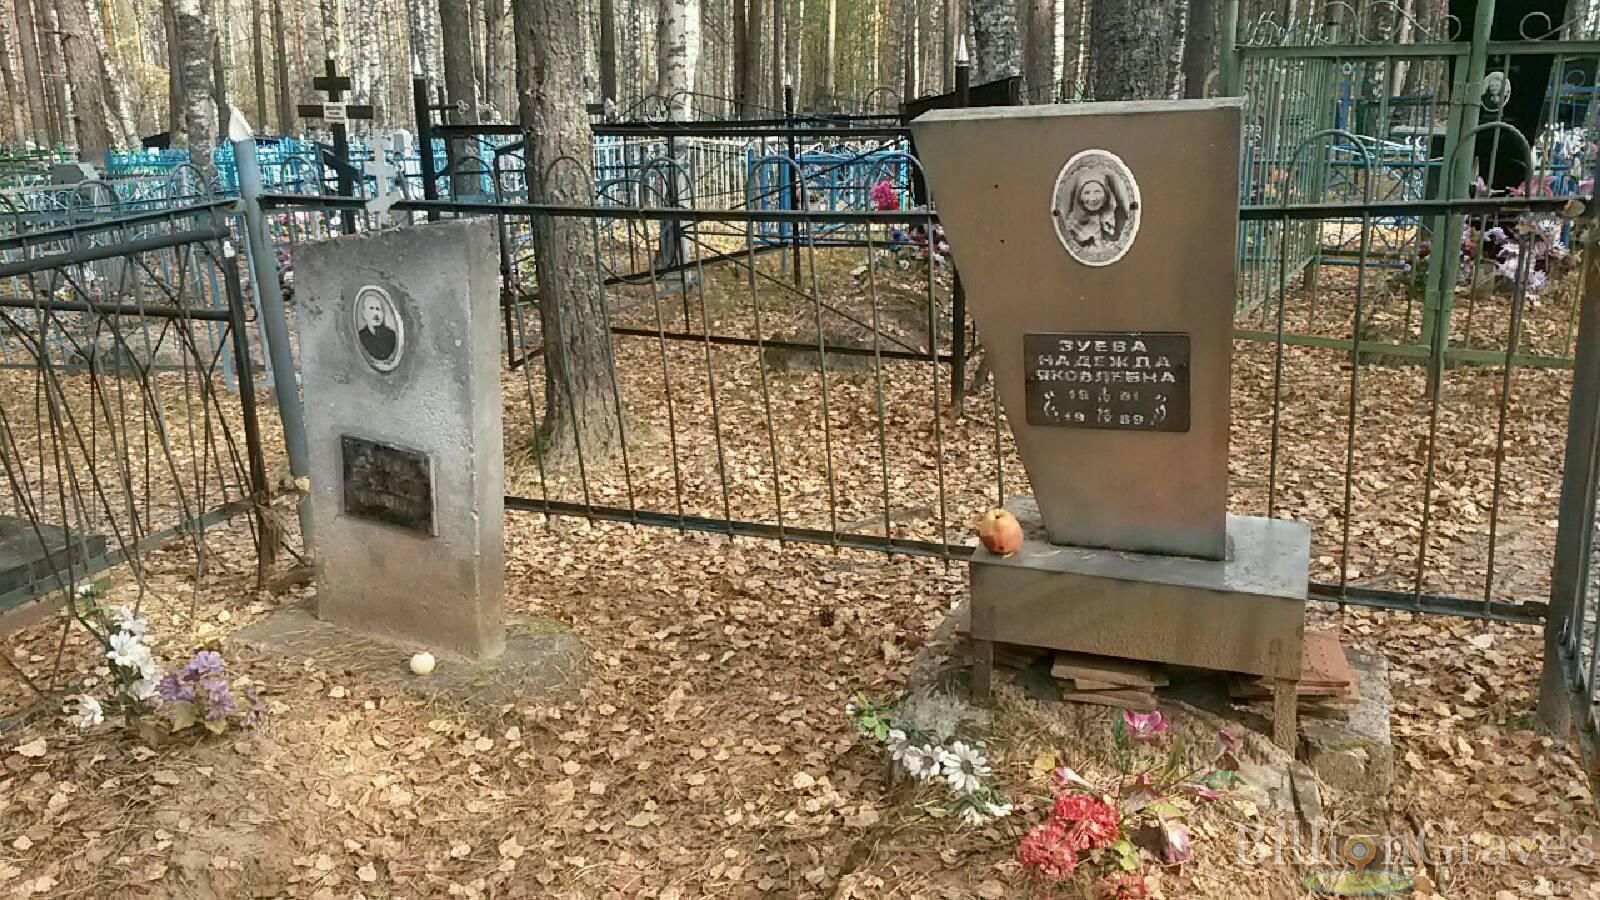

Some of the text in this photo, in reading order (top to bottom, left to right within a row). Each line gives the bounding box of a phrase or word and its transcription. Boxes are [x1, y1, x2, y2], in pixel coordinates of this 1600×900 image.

[1058, 340, 1148, 353] ЗУЕВА
[1038, 354, 1172, 368] НАДЕЖДА
[1035, 369, 1176, 384] ЯКОВЛЕВНА
